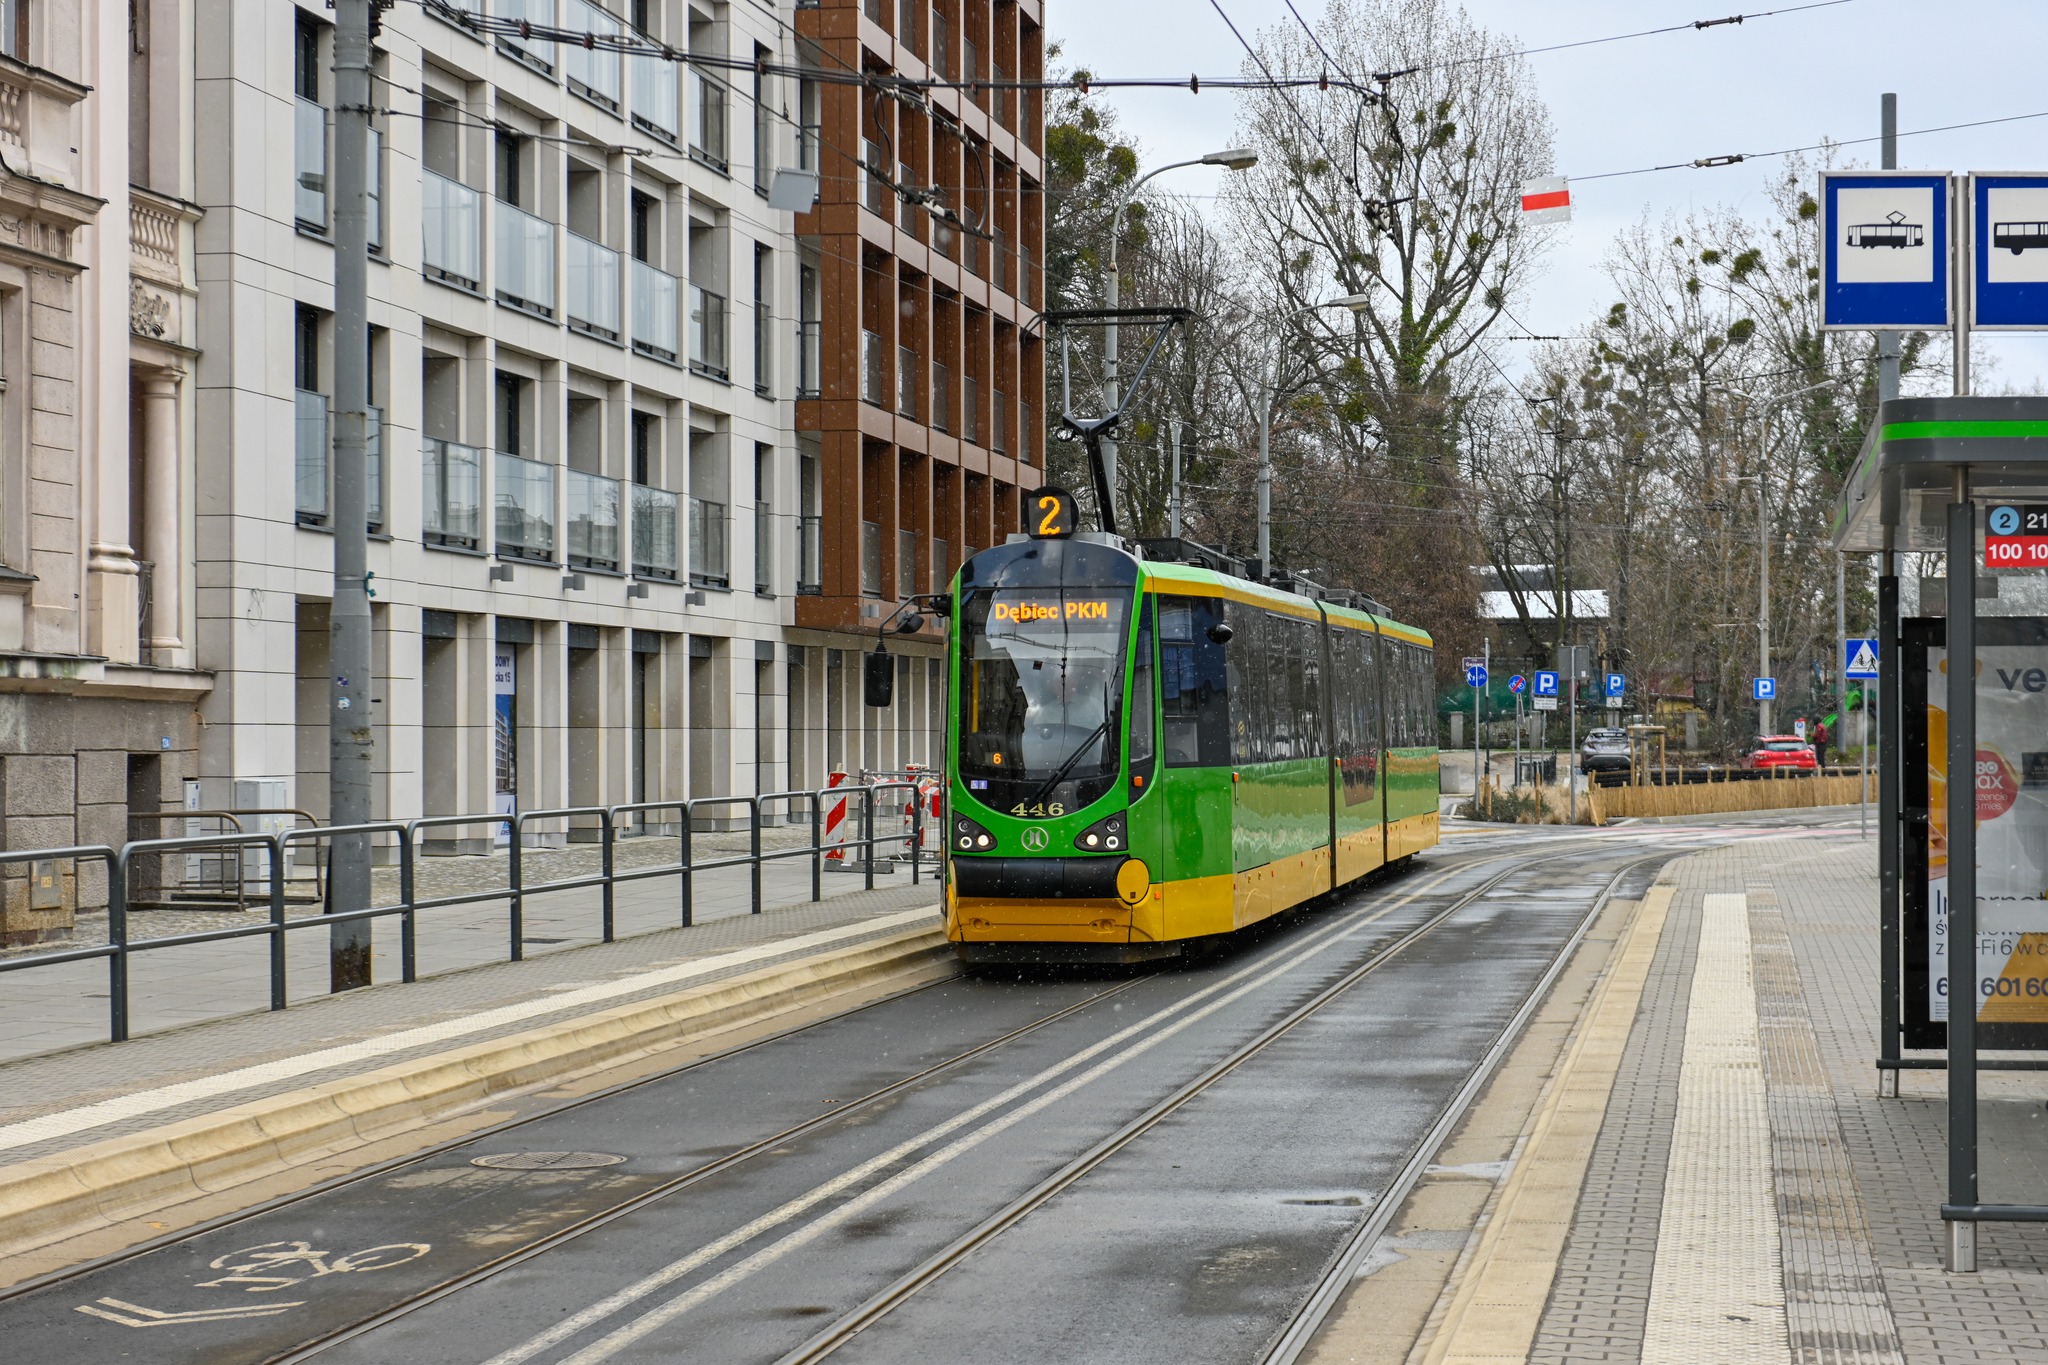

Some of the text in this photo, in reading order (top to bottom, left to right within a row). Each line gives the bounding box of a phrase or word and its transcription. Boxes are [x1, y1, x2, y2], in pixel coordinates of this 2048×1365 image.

[1039, 496, 1060, 535] 2
[1999, 513, 2048, 528] 2 21
[1989, 543, 2023, 559] 100
[995, 602, 1108, 623] Dębiec PKM
[1540, 674, 1553, 692] P
[1610, 676, 1621, 690] P
[1758, 680, 1771, 696] P
[1996, 668, 2047, 692] ve
[993, 753, 1002, 764] 6
[1976, 776, 2004, 789] ax
[1011, 803, 1064, 816] 446
[2000, 939, 2013, 955] 6
[2017, 944, 2032, 955] w
